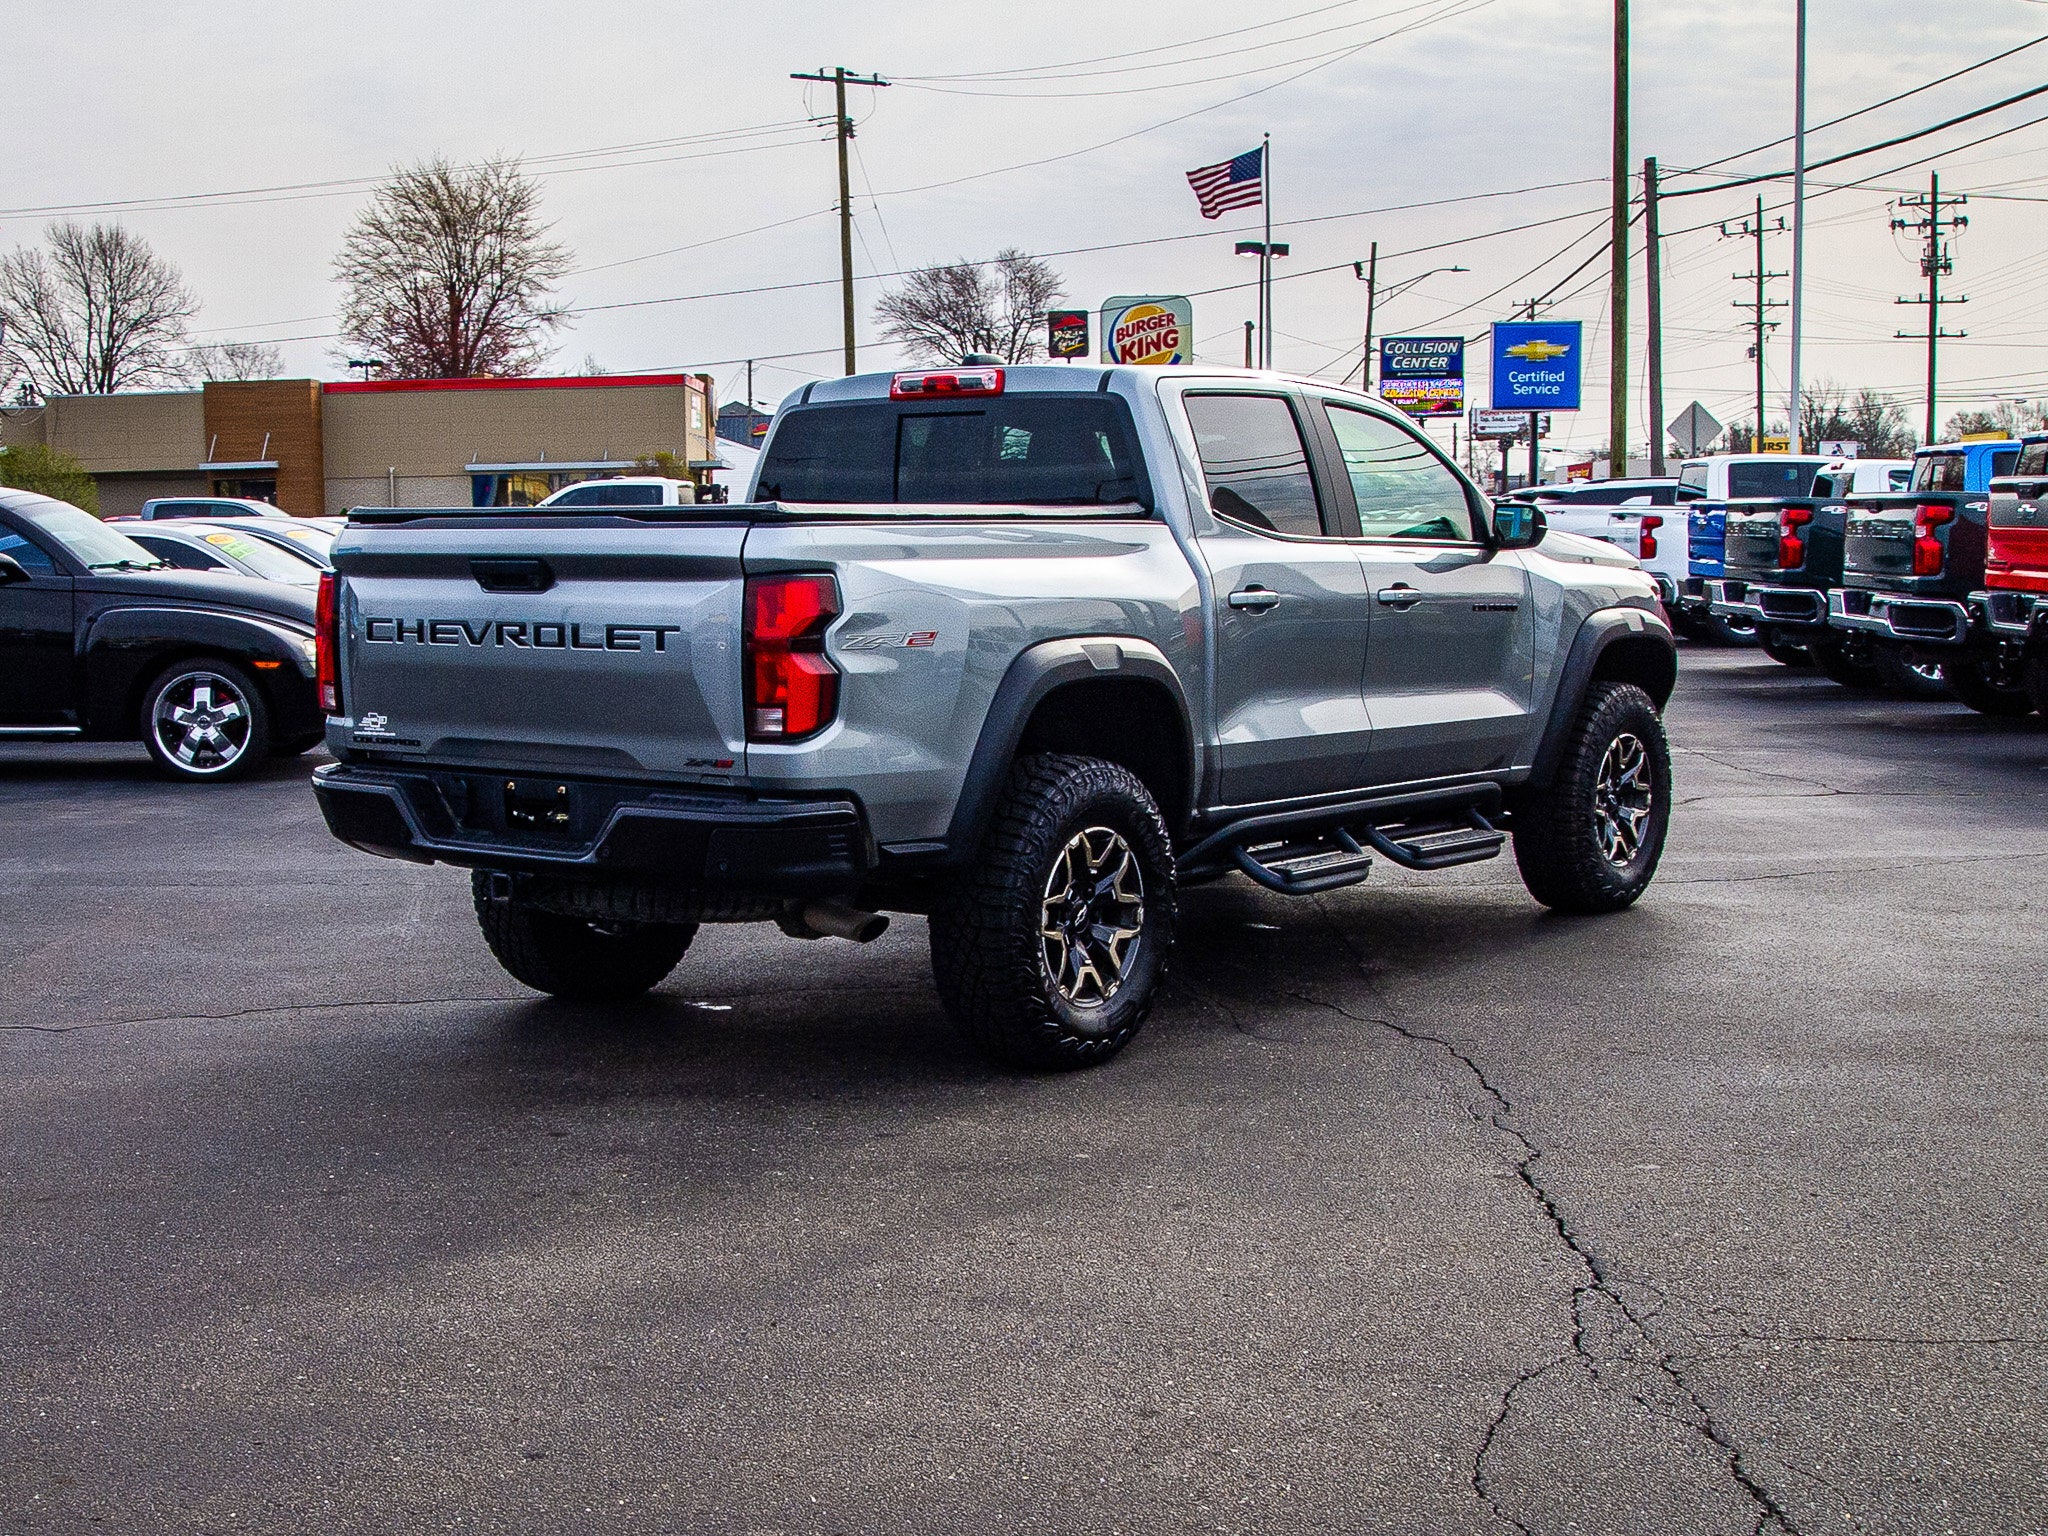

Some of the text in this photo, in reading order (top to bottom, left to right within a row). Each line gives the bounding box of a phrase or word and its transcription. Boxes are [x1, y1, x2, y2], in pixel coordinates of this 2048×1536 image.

[1116, 313, 1176, 343] BURGER
[1120, 329, 1179, 364] KING
[1384, 342, 1459, 354] COLLISION
[1392, 356, 1448, 369] CENTER
[1508, 370, 1565, 382] Certified
[1513, 383, 1560, 394] Service
[365, 617, 681, 653] CHEVROLET
[841, 630, 939, 651] ZR2
